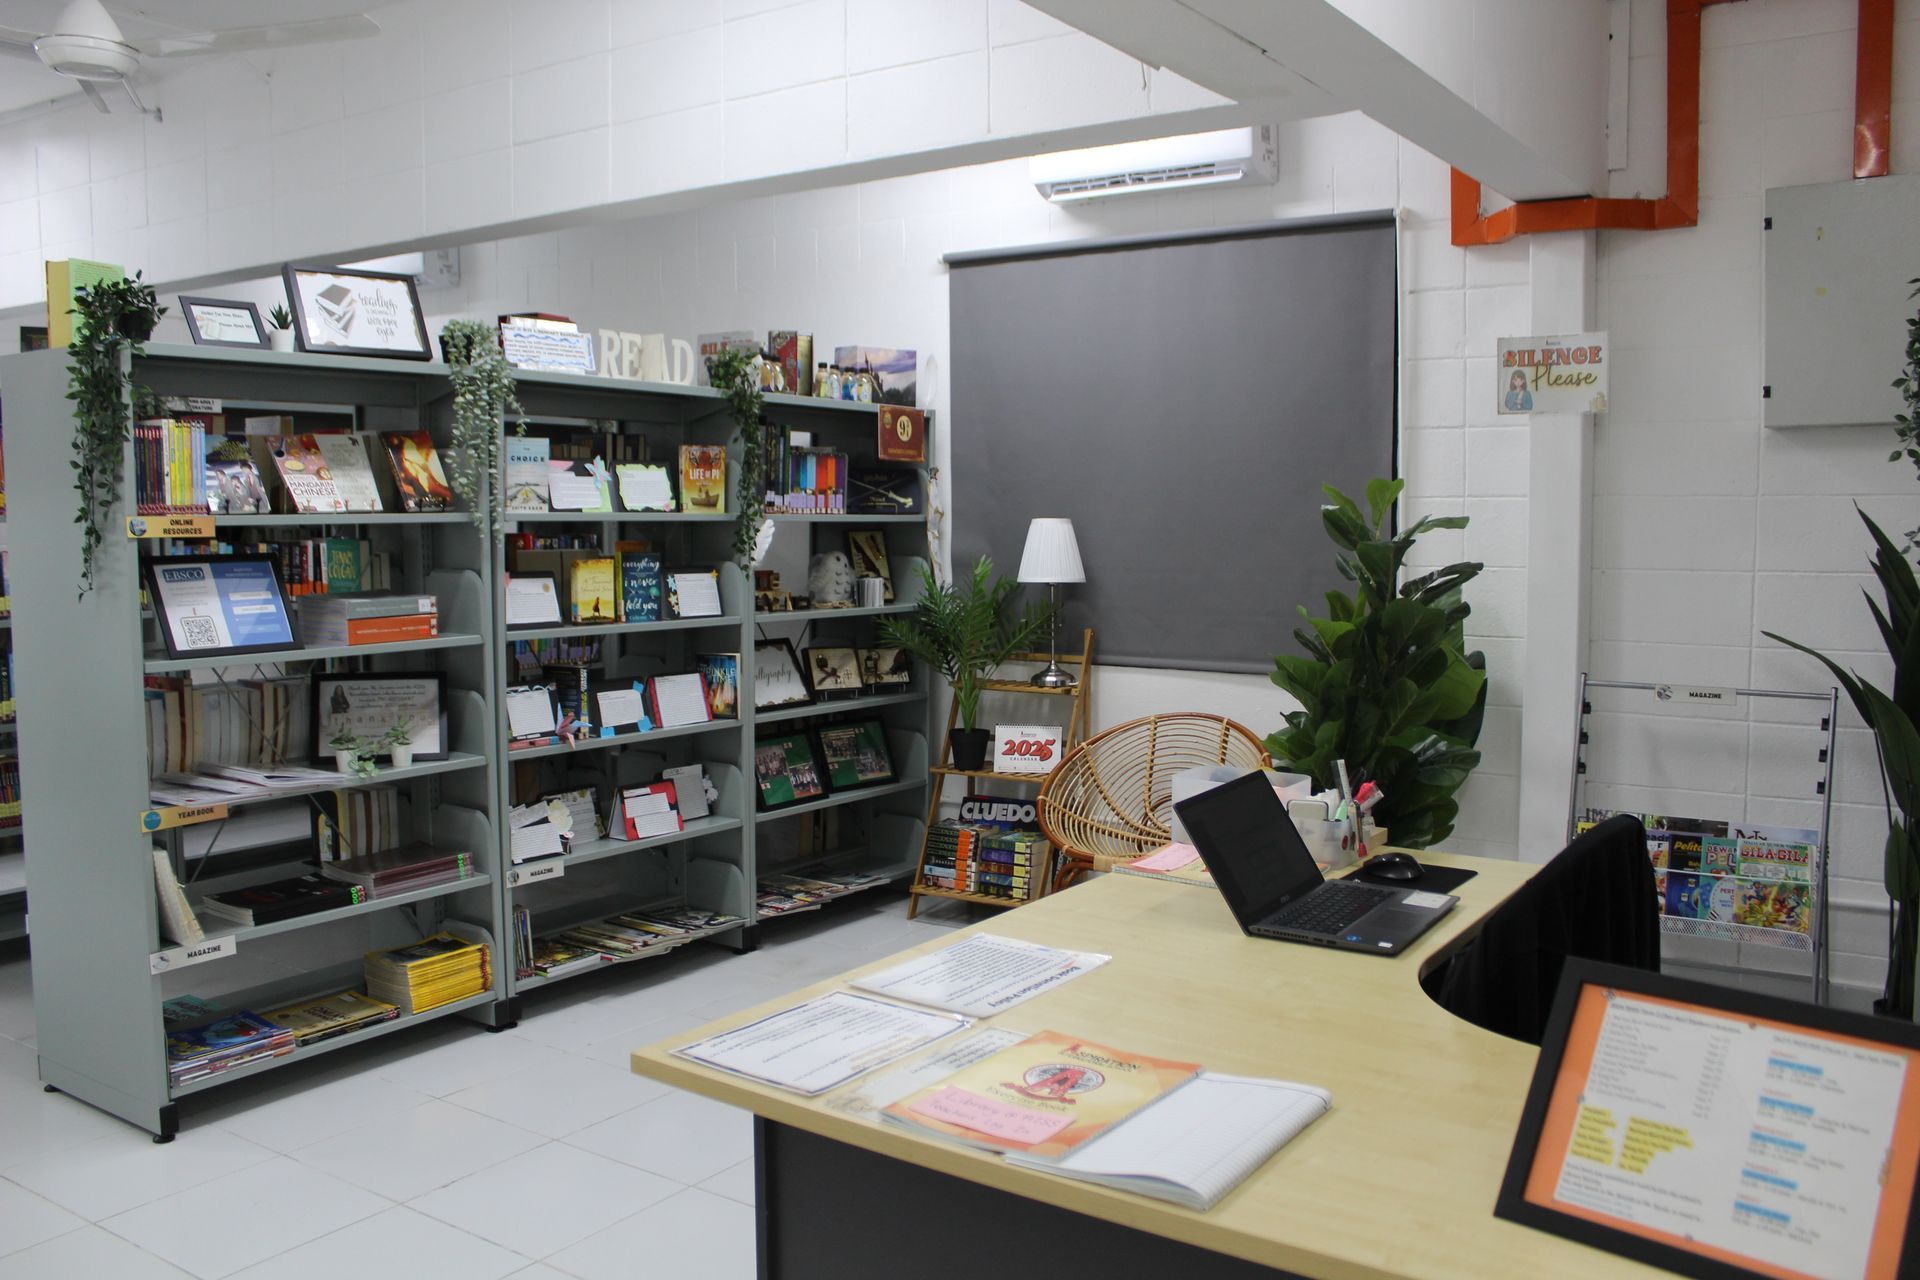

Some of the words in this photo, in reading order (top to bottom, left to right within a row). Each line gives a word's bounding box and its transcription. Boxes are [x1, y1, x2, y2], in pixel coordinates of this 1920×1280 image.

[1502, 345, 1603, 368] SILENCE
[1530, 359, 1598, 392] Please
[511, 455, 545, 463] CHOICE
[293, 487, 336, 496] CHINESE
[164, 569, 204, 581] EBSCO
[1689, 692, 1722, 700] MAGAZINE
[1002, 738, 1056, 761] 2025
[177, 809, 196, 819] YEAR
[196, 807, 214, 816] BOOK
[961, 801, 1036, 822] CLUEDO
[530, 867, 554, 877] MAGAZINE
[187, 944, 222, 959] MAGAZINE
